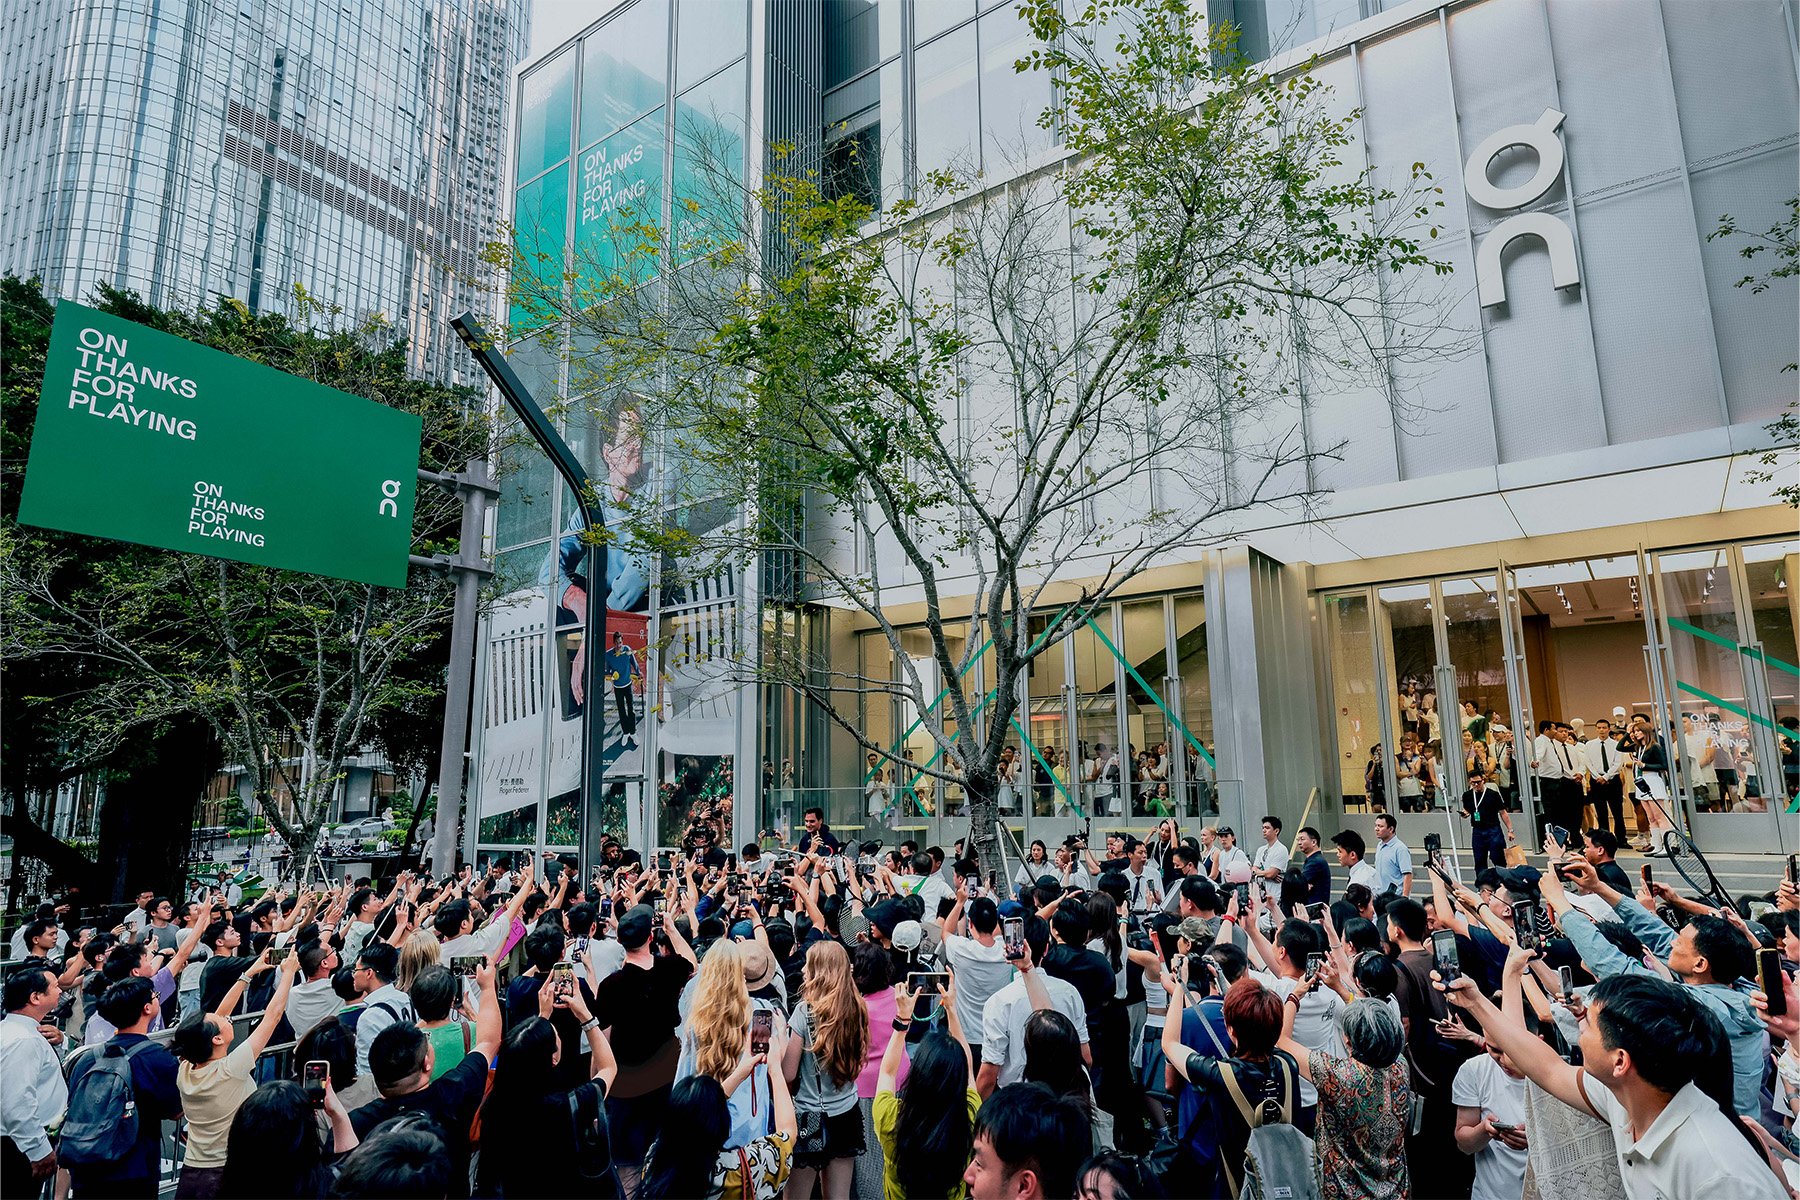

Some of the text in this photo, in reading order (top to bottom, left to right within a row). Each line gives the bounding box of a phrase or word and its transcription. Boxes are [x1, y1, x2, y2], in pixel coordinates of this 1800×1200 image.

[584, 147, 607, 172] ON
[584, 143, 643, 190] THANKS
[582, 178, 645, 226] PLAYING
[583, 179, 612, 208] FOR
[79, 327, 128, 358] ON
[72, 368, 135, 403] FOR
[76, 346, 198, 399] THANKS
[68, 389, 197, 441] PLAYING
[194, 481, 223, 498] ON
[190, 507, 228, 527] FOR
[192, 493, 265, 521] THANKS
[188, 520, 265, 548] PLAYING
[1690, 713, 1710, 722] ON
[499, 786, 530, 795] Roger Federer
